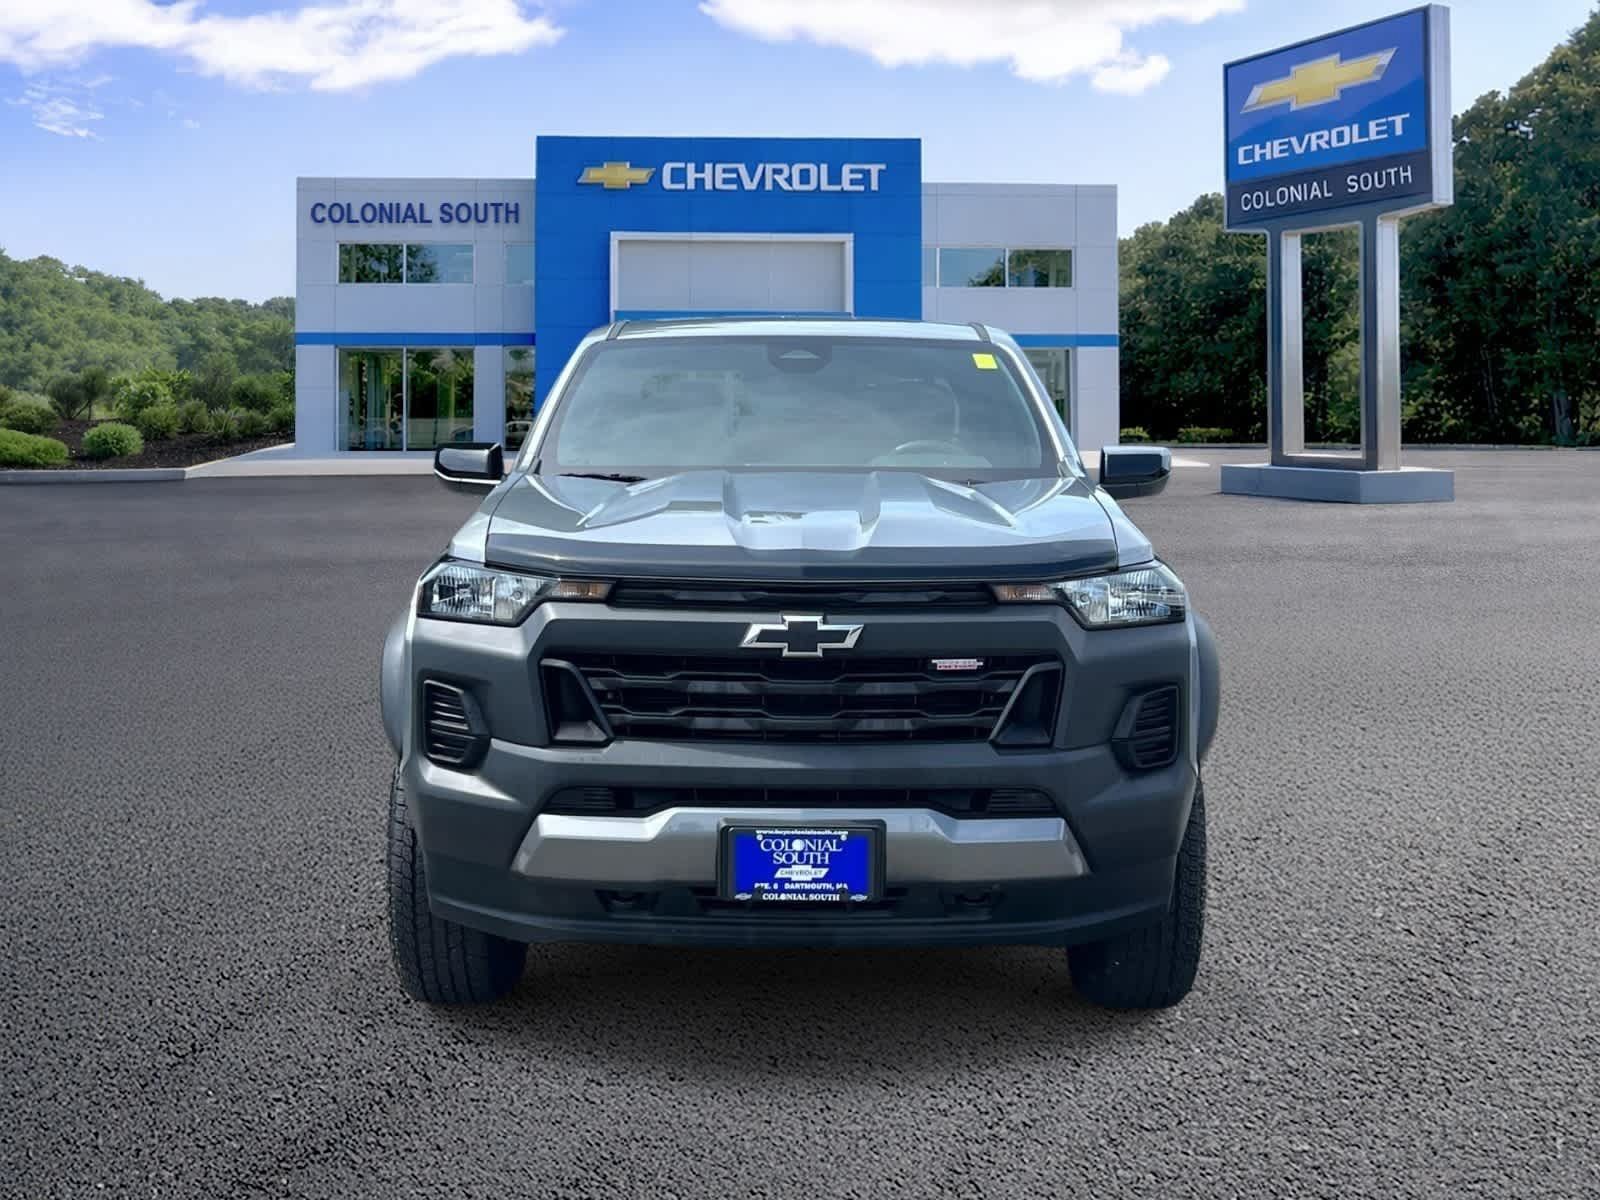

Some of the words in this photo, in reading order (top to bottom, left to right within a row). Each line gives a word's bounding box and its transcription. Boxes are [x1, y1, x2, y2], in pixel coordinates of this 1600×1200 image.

[1238, 113, 1410, 165] CHEVROLET
[661, 161, 887, 192] CHEVROLET
[1240, 180, 1333, 211] COLONIAL
[1346, 165, 1413, 194] SOUTH
[310, 202, 432, 225] COLONIAL
[439, 202, 520, 225] SOUTH
[760, 838, 843, 852] COLONIAL
[773, 852, 830, 864] SOUTH
[779, 869, 823, 877] CHEVROLET
[784, 882, 835, 891] DARTMOUTH,
[762, 892, 808, 901] COLONIAL
[809, 892, 840, 901] SOUTH
